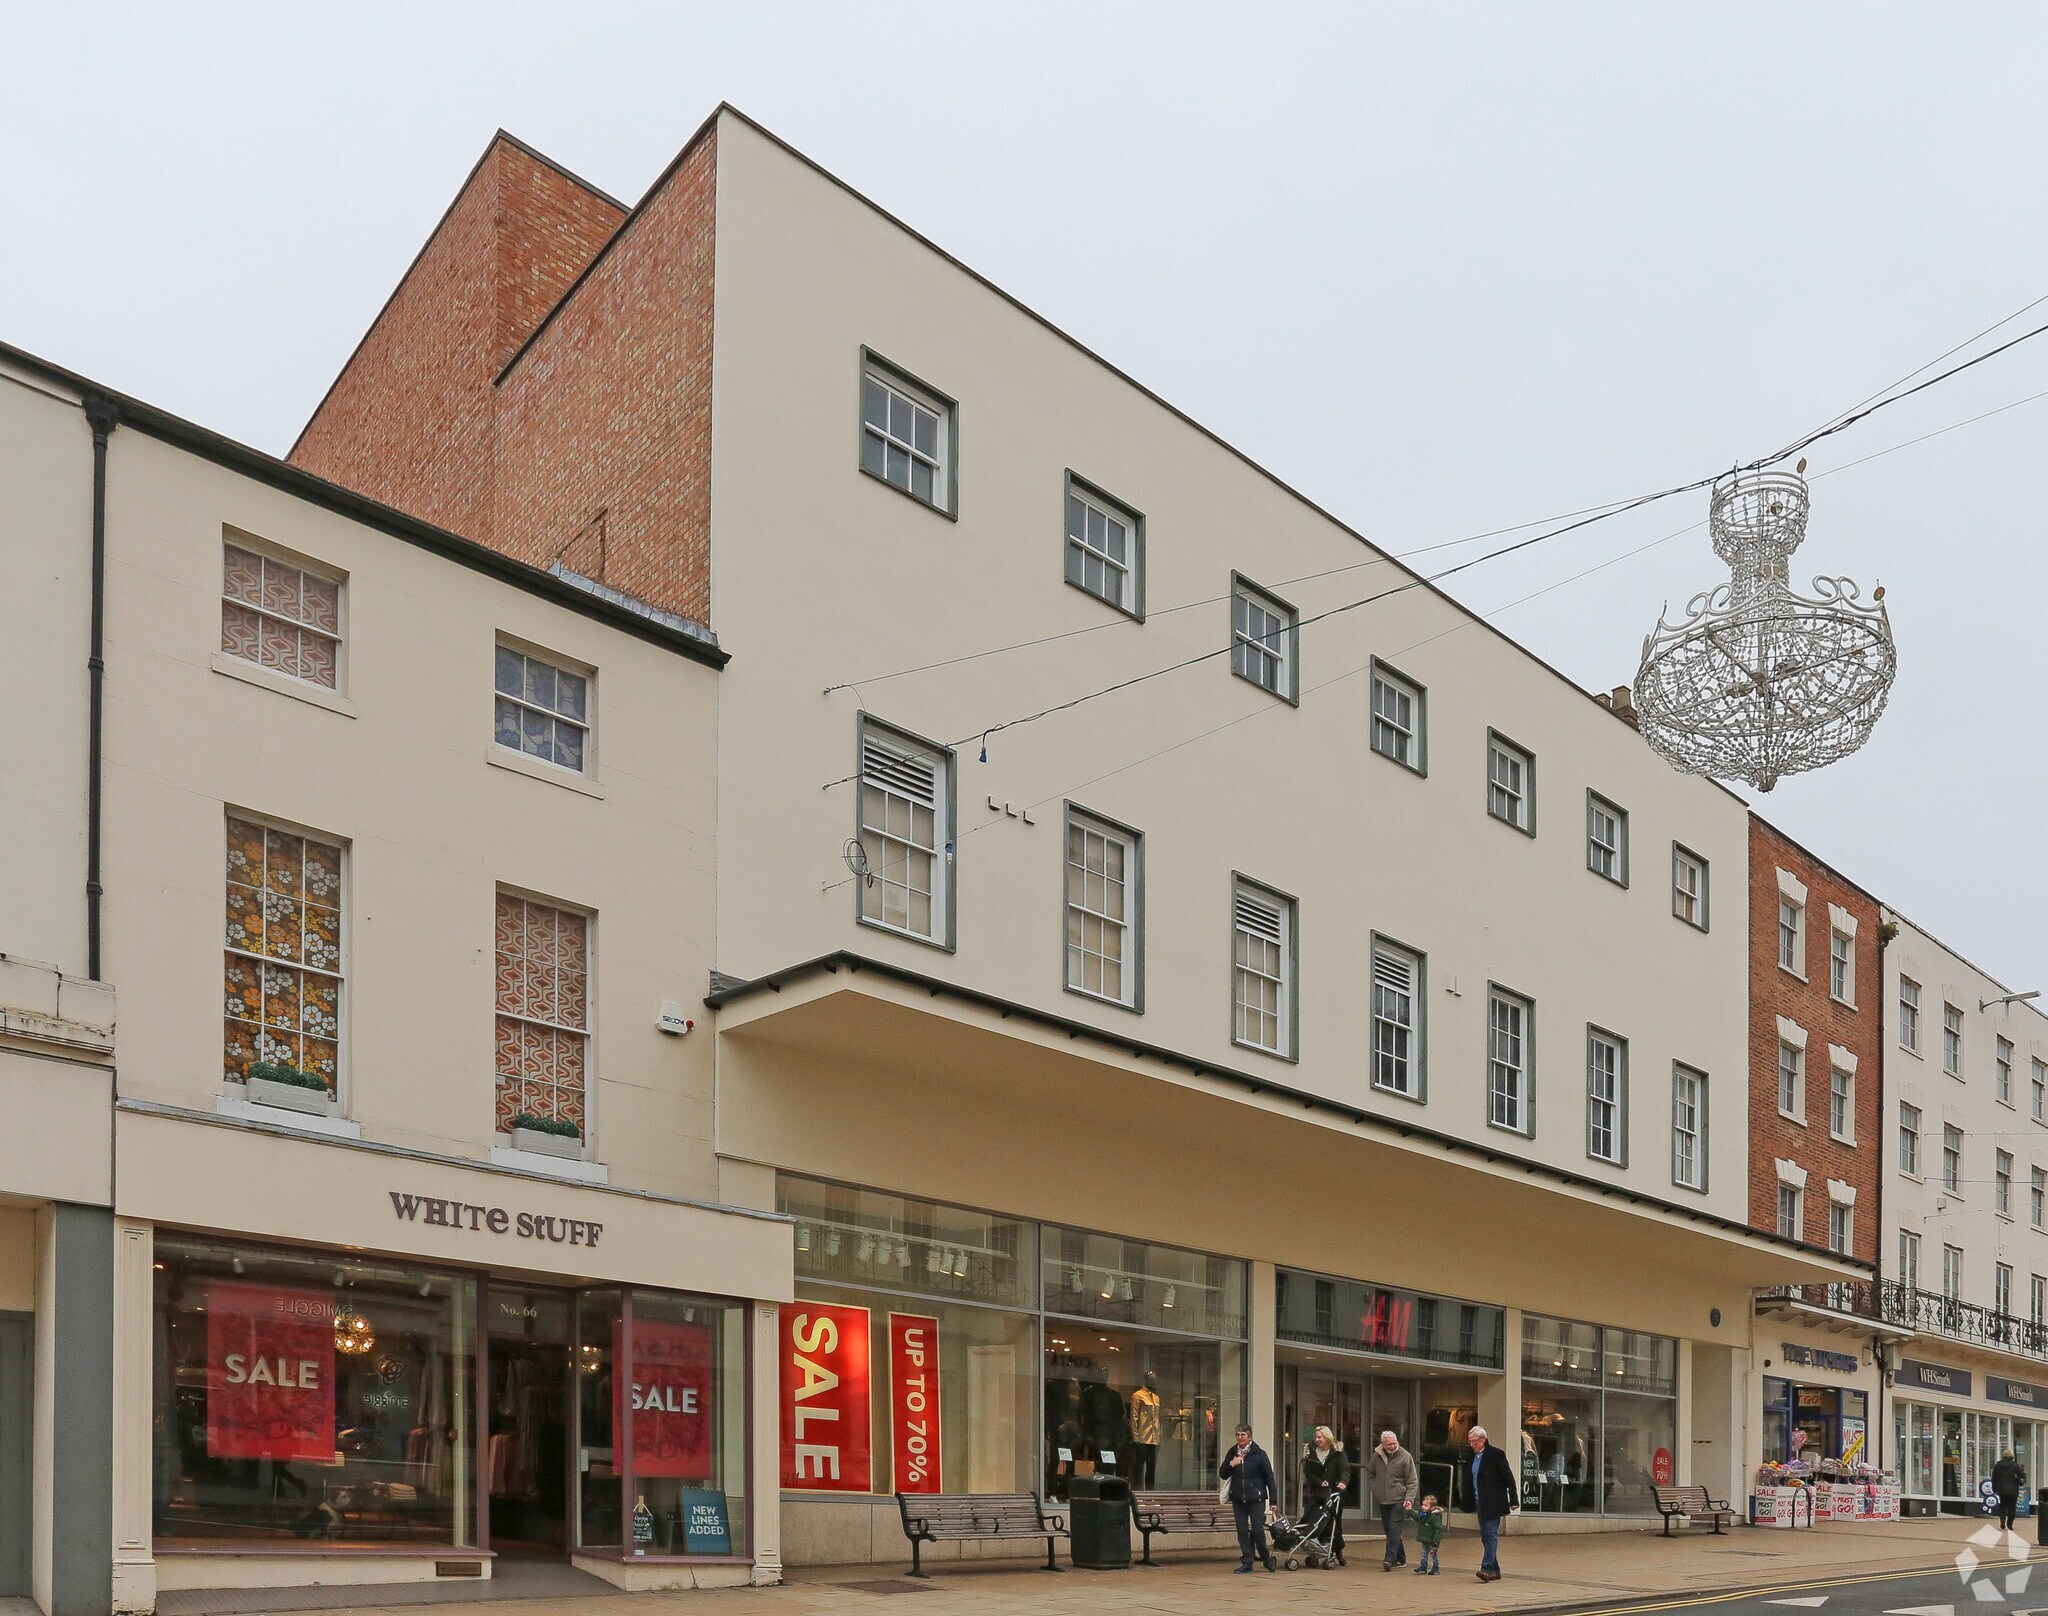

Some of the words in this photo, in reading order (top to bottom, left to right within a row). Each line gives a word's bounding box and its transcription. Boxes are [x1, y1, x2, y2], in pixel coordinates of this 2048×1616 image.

[662, 1015, 685, 1026] SECOM
[501, 1303, 520, 1316] No.
[523, 1305, 537, 1318] 66
[904, 1328, 925, 1368] UP
[1781, 1342, 1811, 1367] THE
[1811, 1348, 1858, 1373] WORKS
[225, 1353, 320, 1390] SALE
[1919, 1367, 1951, 1387] WHSmith
[632, 1383, 698, 1414] SALE
[792, 1313, 840, 1480] SALE
[905, 1373, 926, 1413] TO
[2007, 1384, 2034, 1402] WHSmith
[906, 1419, 928, 1483] 70%
[1656, 1456, 1669, 1466] SALE
[1757, 1488, 1777, 1497] SALE
[1522, 1496, 1540, 1505] LADIES
[1837, 1496, 1854, 1505] MUST
[692, 1505, 716, 1515] NEW
[1758, 1508, 1772, 1517] GO!
[1837, 1504, 1854, 1515] GO!
[691, 1515, 720, 1526] LINES
[688, 1525, 725, 1536] ADDED
